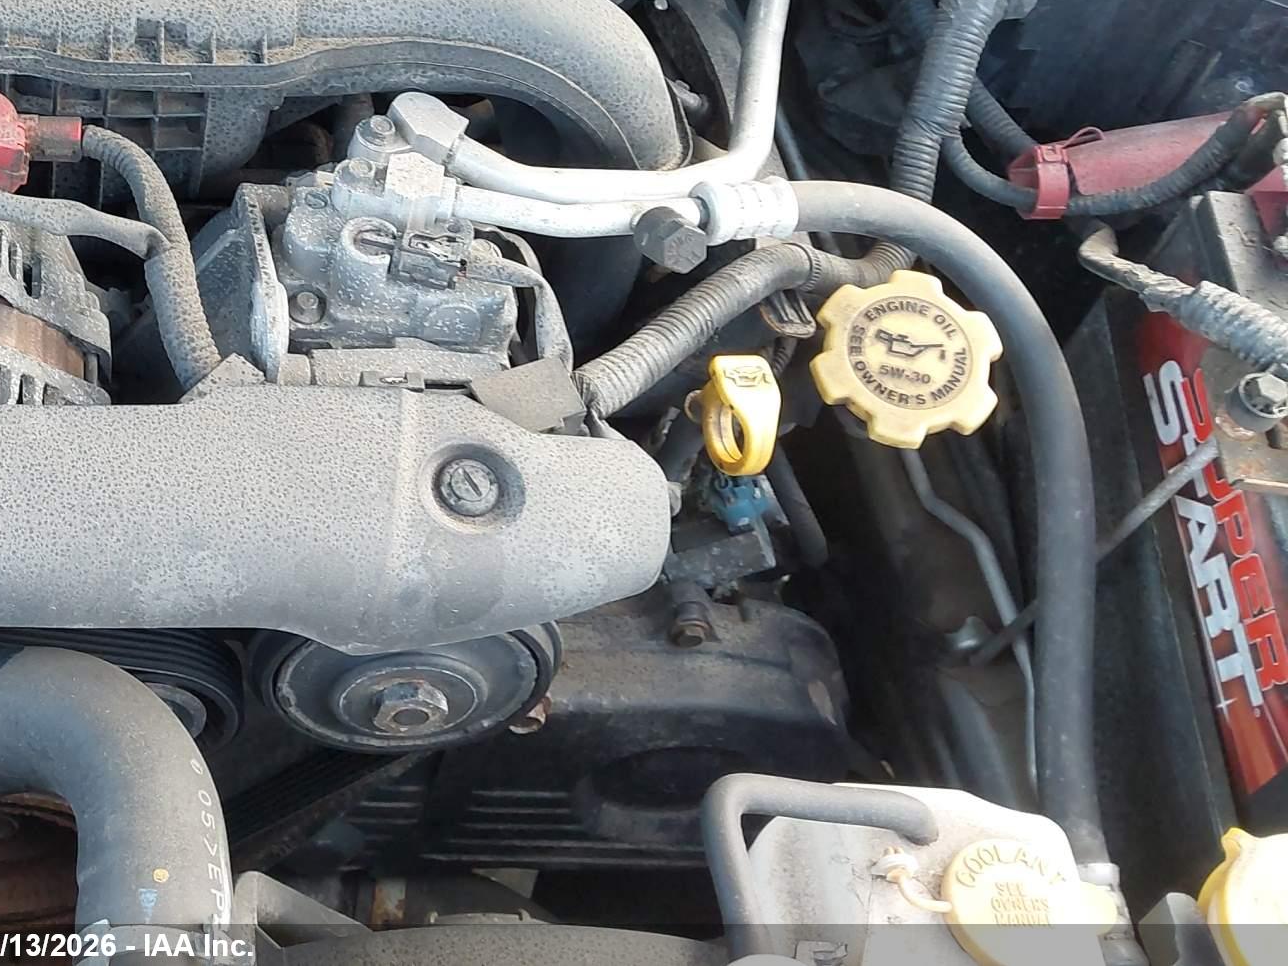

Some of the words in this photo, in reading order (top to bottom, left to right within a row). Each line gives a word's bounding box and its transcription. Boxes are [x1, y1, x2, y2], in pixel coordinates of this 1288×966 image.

[864, 300, 930, 322] ENGINE
[933, 313, 957, 340] OIL
[850, 325, 866, 356] SEE
[854, 360, 927, 405] OWNER'S
[879, 364, 932, 385] 5W-30
[930, 347, 968, 403] MANUAL
